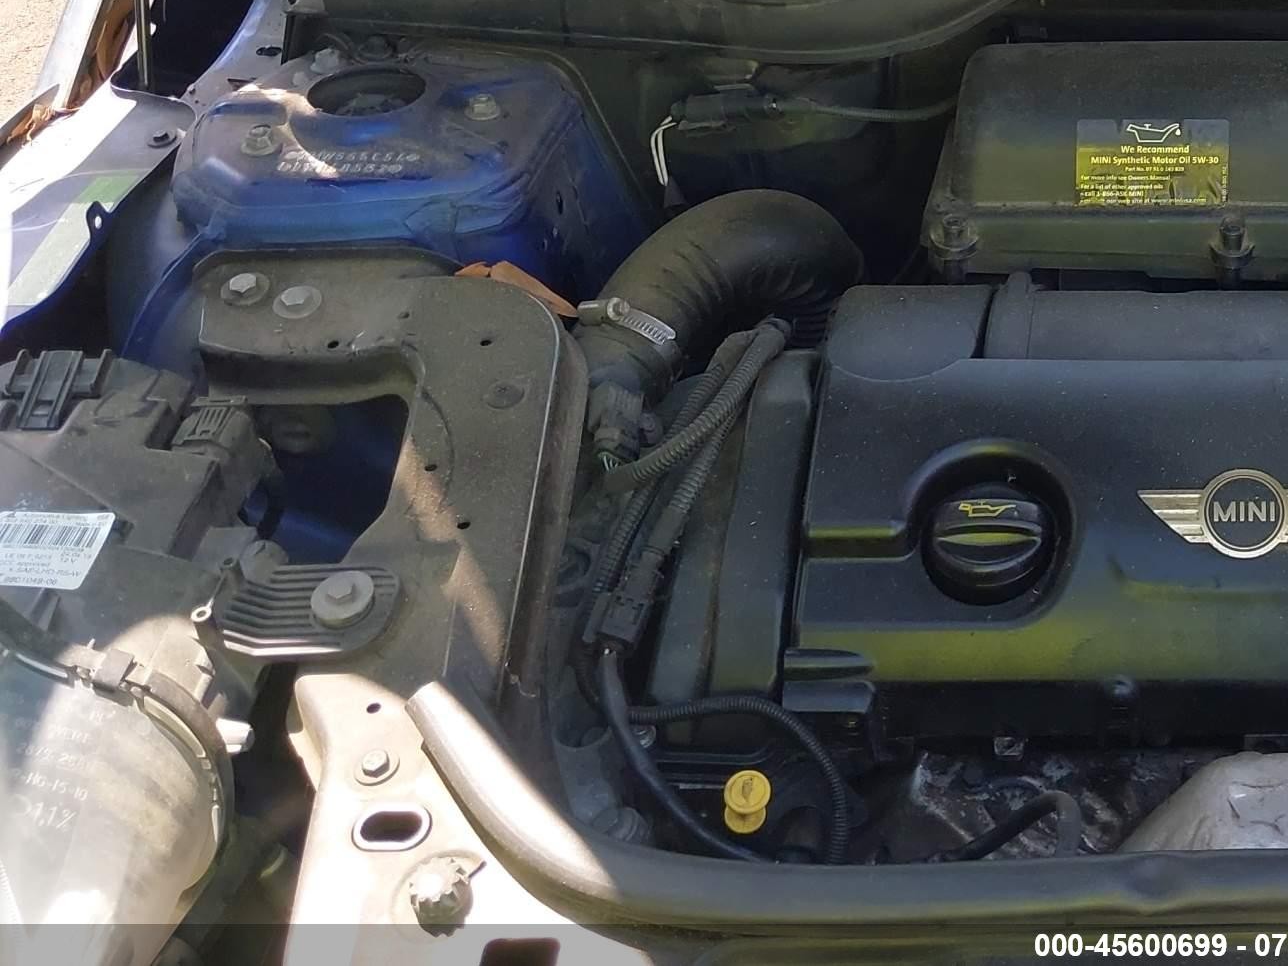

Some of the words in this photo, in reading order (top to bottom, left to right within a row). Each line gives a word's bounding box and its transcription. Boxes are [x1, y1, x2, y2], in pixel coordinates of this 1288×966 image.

[1121, 145, 1135, 154] We
[1137, 145, 1190, 154] Recommend
[1091, 156, 1111, 164] MINI
[1113, 156, 1151, 166] Synthetic
[1152, 156, 1179, 164] Motor
[1179, 156, 1191, 164] Oil
[1192, 156, 1219, 164] 5W-30
[1127, 183, 1153, 191] approved
[1213, 500, 1276, 523] MINI
